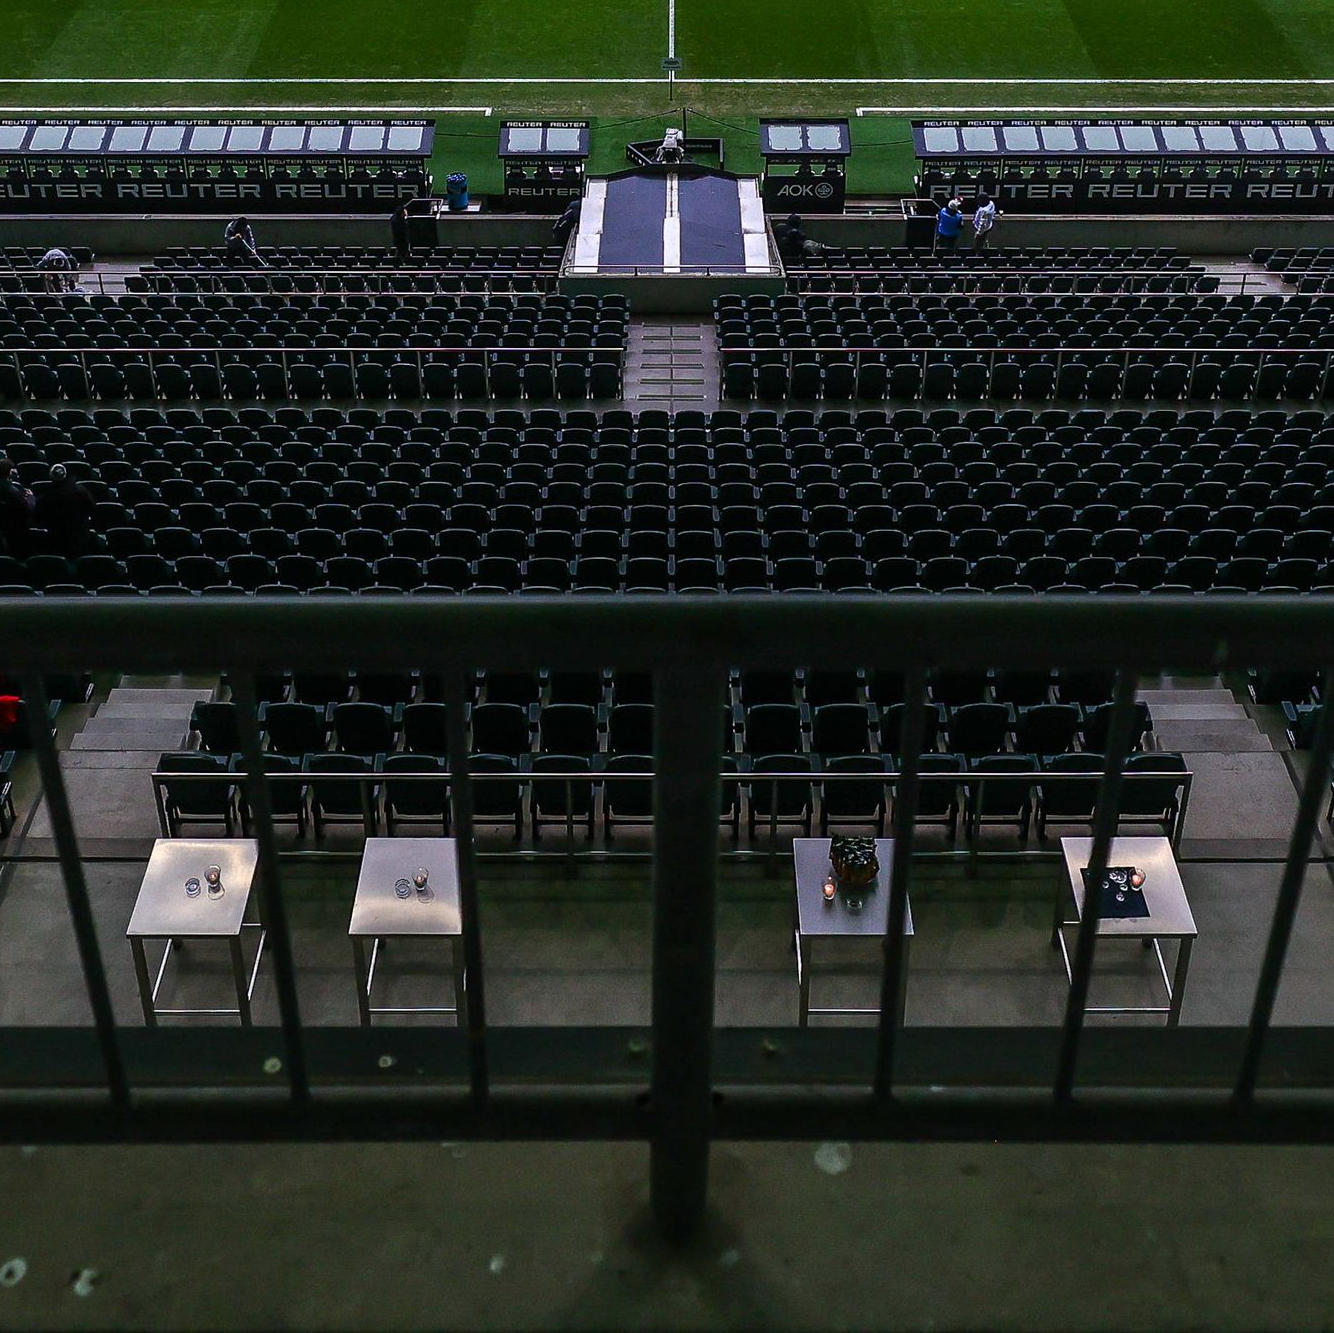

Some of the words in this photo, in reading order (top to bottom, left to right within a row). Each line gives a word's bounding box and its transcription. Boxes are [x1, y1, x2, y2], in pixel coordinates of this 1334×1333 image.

[116, 184, 262, 199] REUTER
[274, 184, 420, 199] REUTER
[508, 188, 580, 197] REUTER
[776, 184, 814, 197] AOK
[928, 183, 1073, 200] REUTER
[1086, 183, 1232, 200] REUTER
